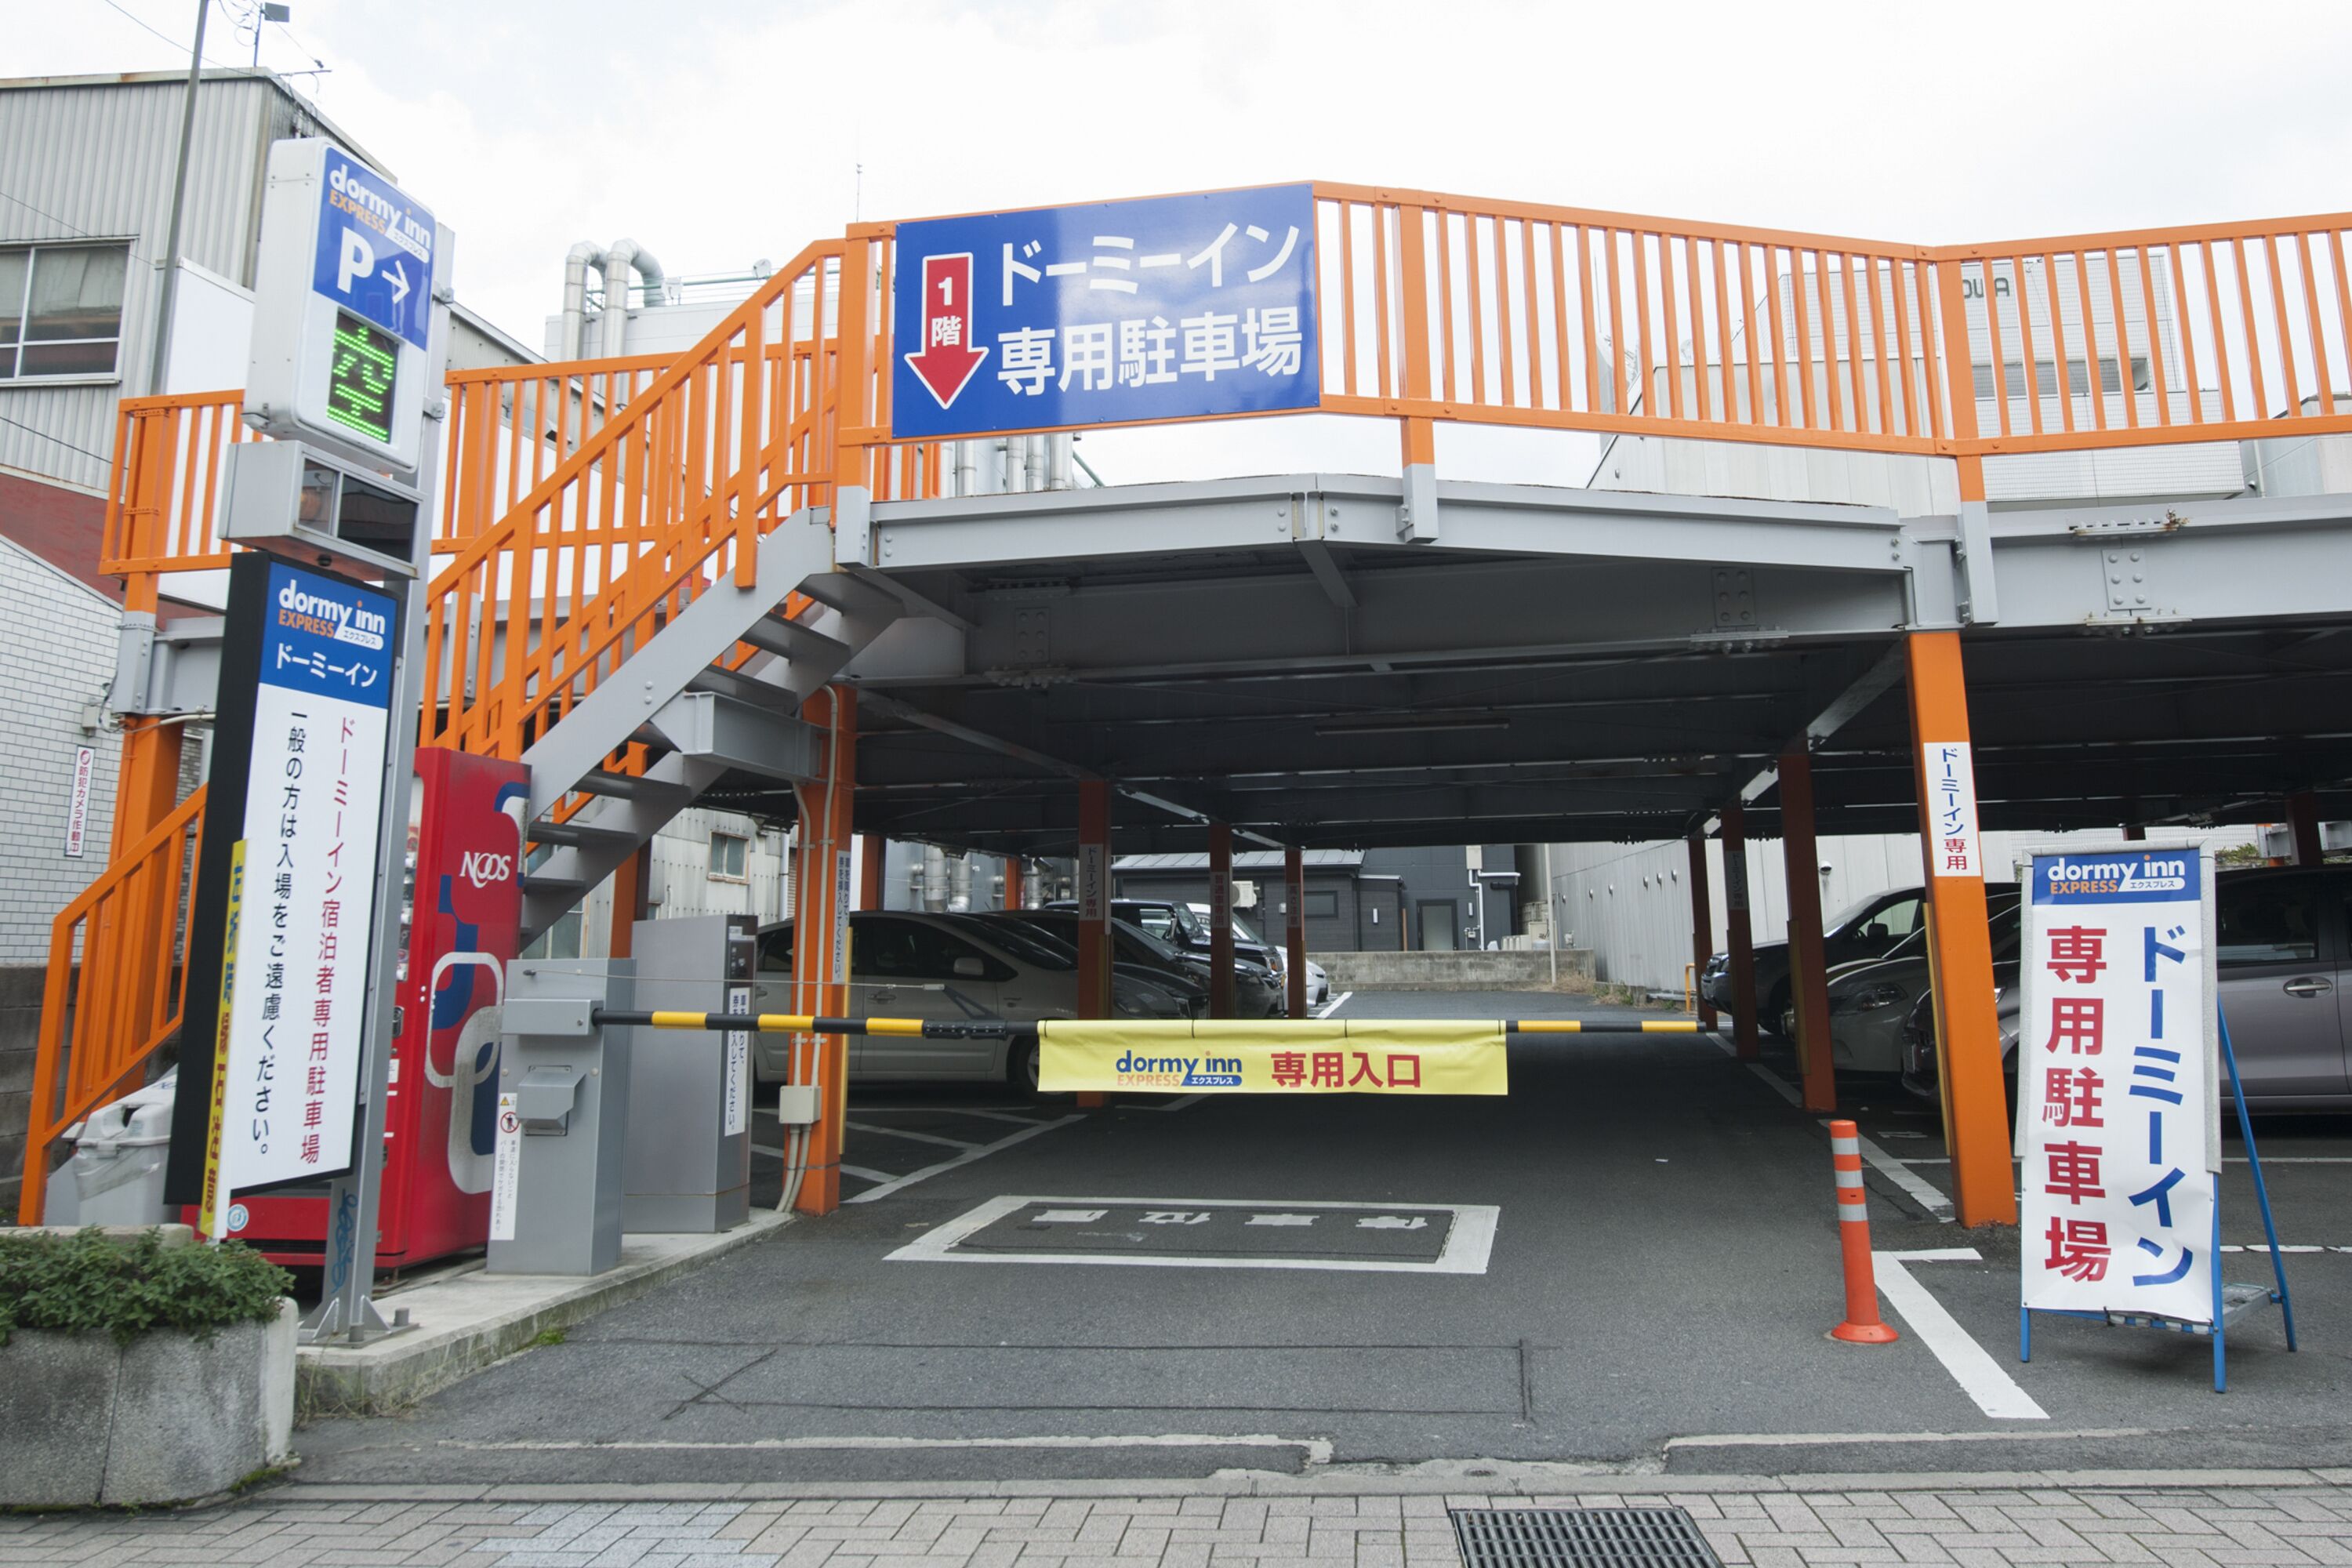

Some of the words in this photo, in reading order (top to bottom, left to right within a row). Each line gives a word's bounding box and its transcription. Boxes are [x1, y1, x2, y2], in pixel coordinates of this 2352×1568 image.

[329, 189, 386, 235] EXPRESS
[330, 164, 401, 235] dormy
[405, 207, 430, 250] inn
[337, 226, 375, 294] P
[1002, 222, 1300, 307] ドーミーイン
[931, 276, 961, 347] 1階
[997, 307, 1303, 396] 専用駐車場
[325, 326, 394, 441] 空
[278, 579, 353, 638] dormy
[355, 600, 386, 635] inn
[278, 608, 336, 638] EXPRESS
[343, 630, 377, 646] エクスプレス
[277, 642, 377, 688] ドーミーイン
[1940, 747, 1968, 870] ドーミーイン専用
[2048, 858, 2138, 892] dormy
[2144, 855, 2186, 878] inn
[2050, 880, 2118, 895] EXPRESS
[2130, 880, 2176, 889] エクスプレス
[252, 712, 308, 1154] 一般の方は入場をご遠慮ください。
[300, 717, 355, 1164] ドーミーイン宿泊者専用駐車場
[1116, 1050, 1200, 1087] dormy
[1205, 1051, 1243, 1073] inn
[1117, 1073, 1181, 1087] EXPRESS
[1191, 1076, 1234, 1086] エクスプレス
[1270, 1051, 1421, 1088] 専用入口
[2042, 925, 2111, 1283] 専用駐車場
[2127, 924, 2194, 1287] ドーミーイン
